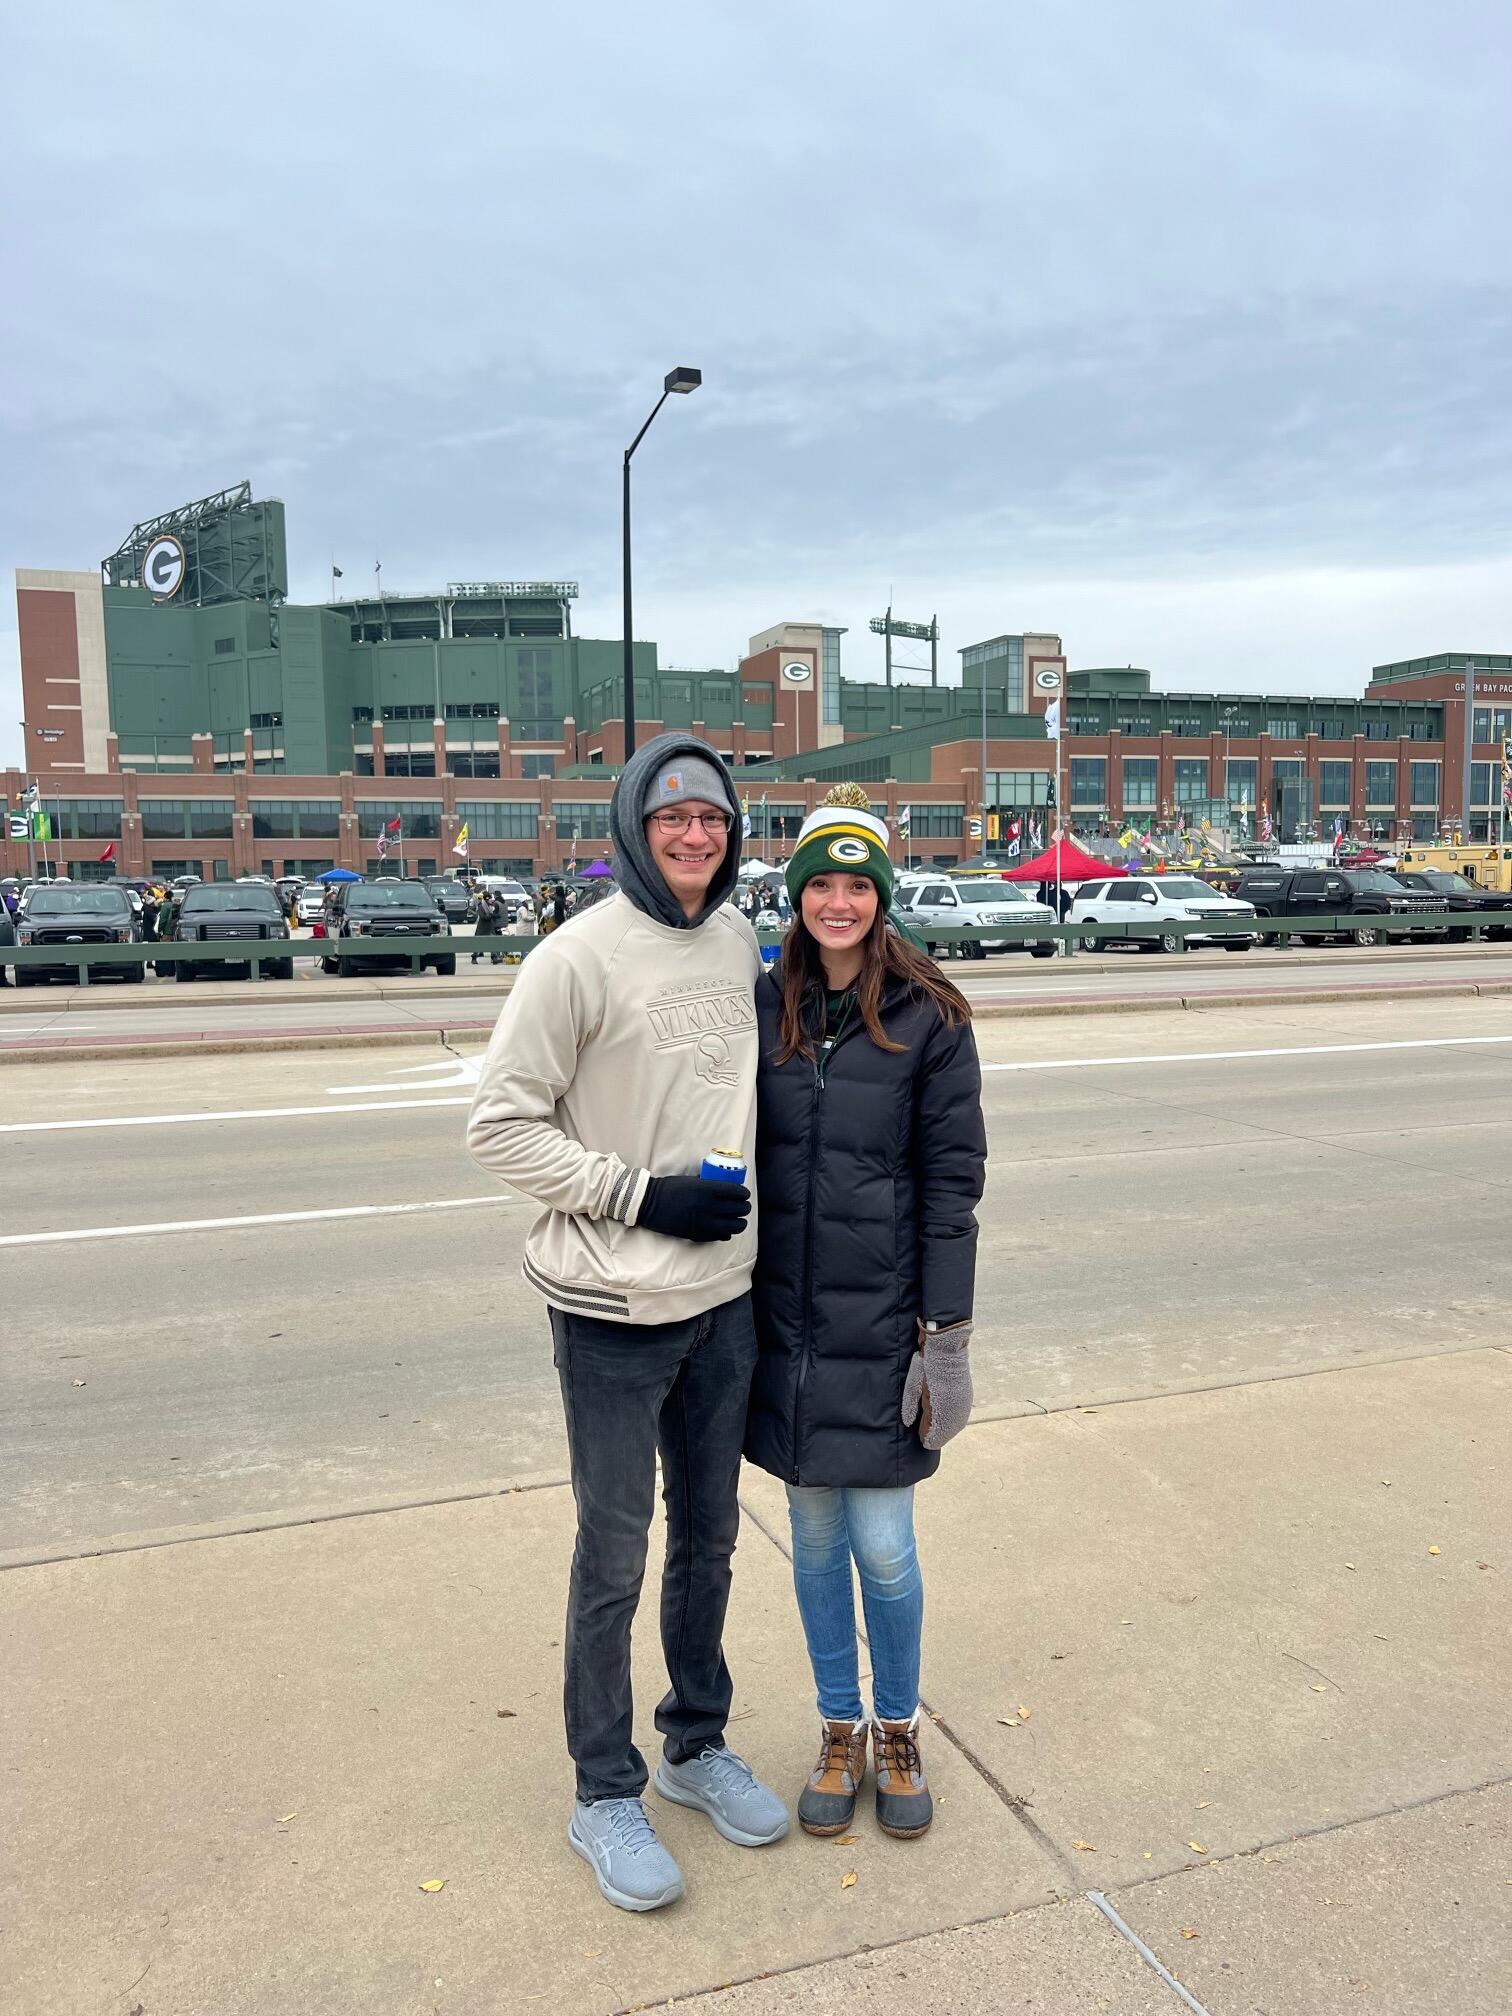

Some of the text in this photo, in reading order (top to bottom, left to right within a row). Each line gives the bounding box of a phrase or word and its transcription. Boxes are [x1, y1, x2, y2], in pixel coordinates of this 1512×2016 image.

[144, 541, 182, 593] G
[783, 662, 811, 681] G
[1036, 670, 1061, 689] G
[1483, 683, 1497, 693] BAY
[830, 838, 869, 862] G
[646, 993, 755, 1041] VIKINGS
